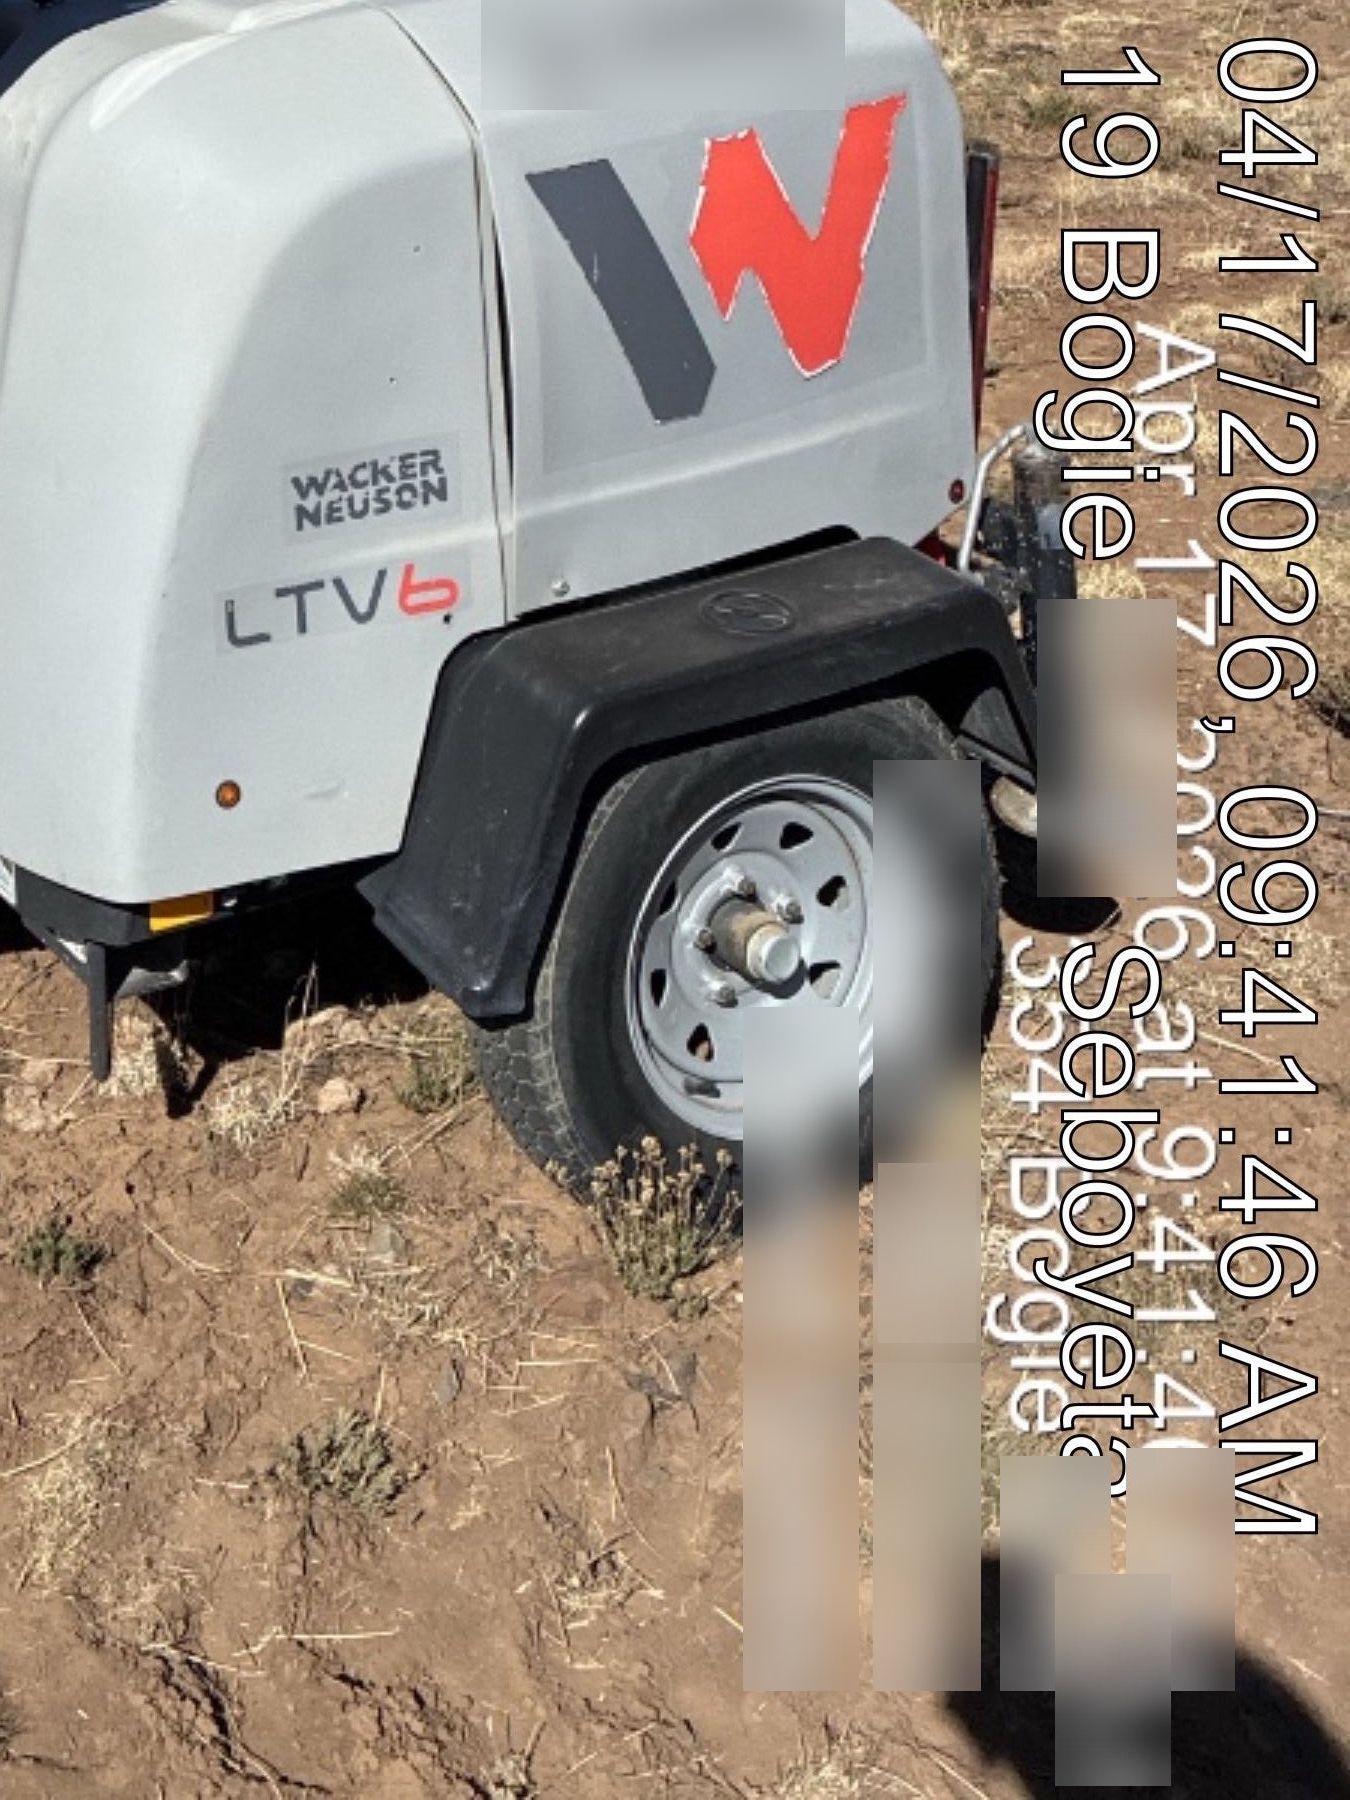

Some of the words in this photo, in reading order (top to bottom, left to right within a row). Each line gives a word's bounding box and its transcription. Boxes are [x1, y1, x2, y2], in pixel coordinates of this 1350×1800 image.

[291, 449, 444, 500] WACKER
[294, 476, 447, 531] NEUSON
[224, 563, 459, 648] LTV6
